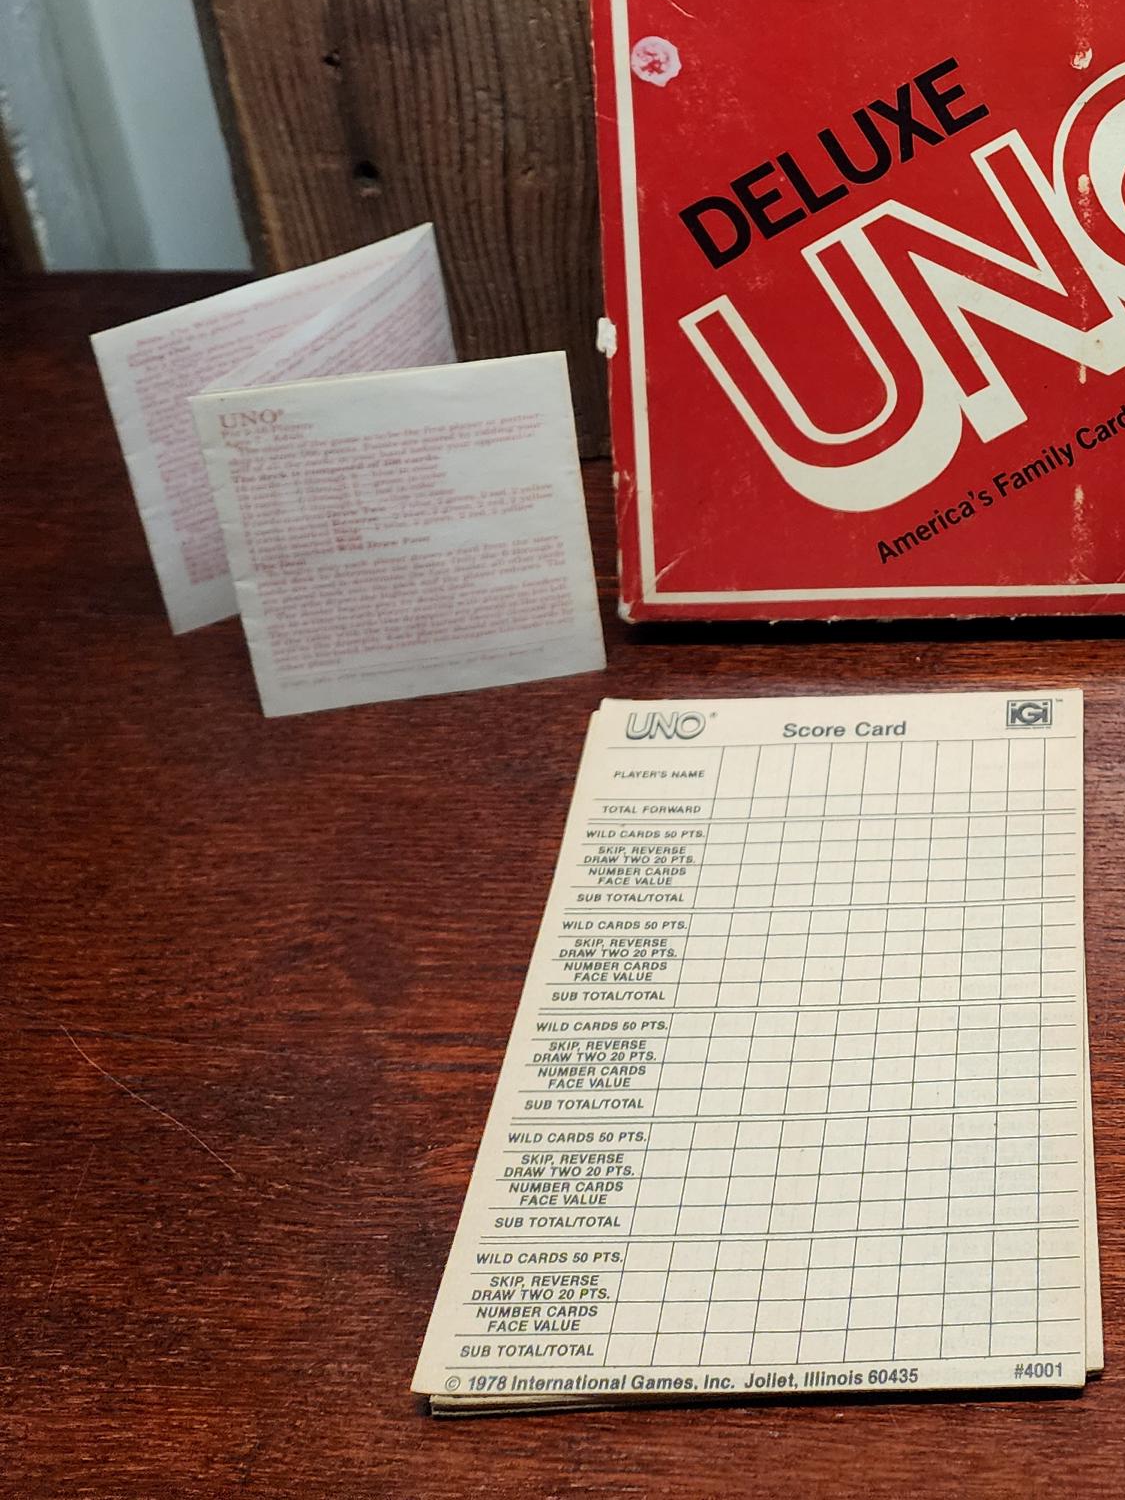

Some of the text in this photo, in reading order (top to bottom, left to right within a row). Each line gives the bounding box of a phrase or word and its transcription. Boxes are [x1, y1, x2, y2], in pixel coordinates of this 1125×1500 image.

[679, 58, 989, 268] DELUXE
[876, 491, 994, 564] America's
[992, 443, 1076, 498] Family
[626, 711, 706, 740] UNO
[783, 721, 907, 738] Score Card
[614, 770, 705, 778] PLAYER'S NAME
[602, 805, 701, 814] TOTAL FORWARD
[536, 1021, 668, 1032] WILD CARDS 50 PTS.
[550, 1040, 647, 1052] SKIP, REVERSE
[533, 1051, 657, 1063] DRAW TWO 20 PTS.
[537, 1066, 646, 1077] NUMBER CARDS
[548, 1078, 631, 1089] FACE VALUE
[525, 1098, 644, 1110] SUB TOTAL/TOTAL
[476, 1252, 623, 1264] WILD CARDS 50 PTS.
[490, 1275, 599, 1288] SKIP, REVERSE
[472, 1288, 610, 1301] DRAW TWO 20 PTS.
[476, 1306, 598, 1318] NUMBER CARDS
[487, 1319, 581, 1332] FACE VALUE
[460, 1344, 595, 1357] SUB TOTAL/TOTAL
[1014, 1362, 1063, 1380] #4001
[468, 1375, 507, 1391] 1978
[511, 1374, 627, 1391] International
[704, 1374, 735, 1389] Inc.
[744, 1372, 798, 1390] Joliet,
[803, 1370, 864, 1387] Illinois
[868, 1368, 918, 1385] 60435
